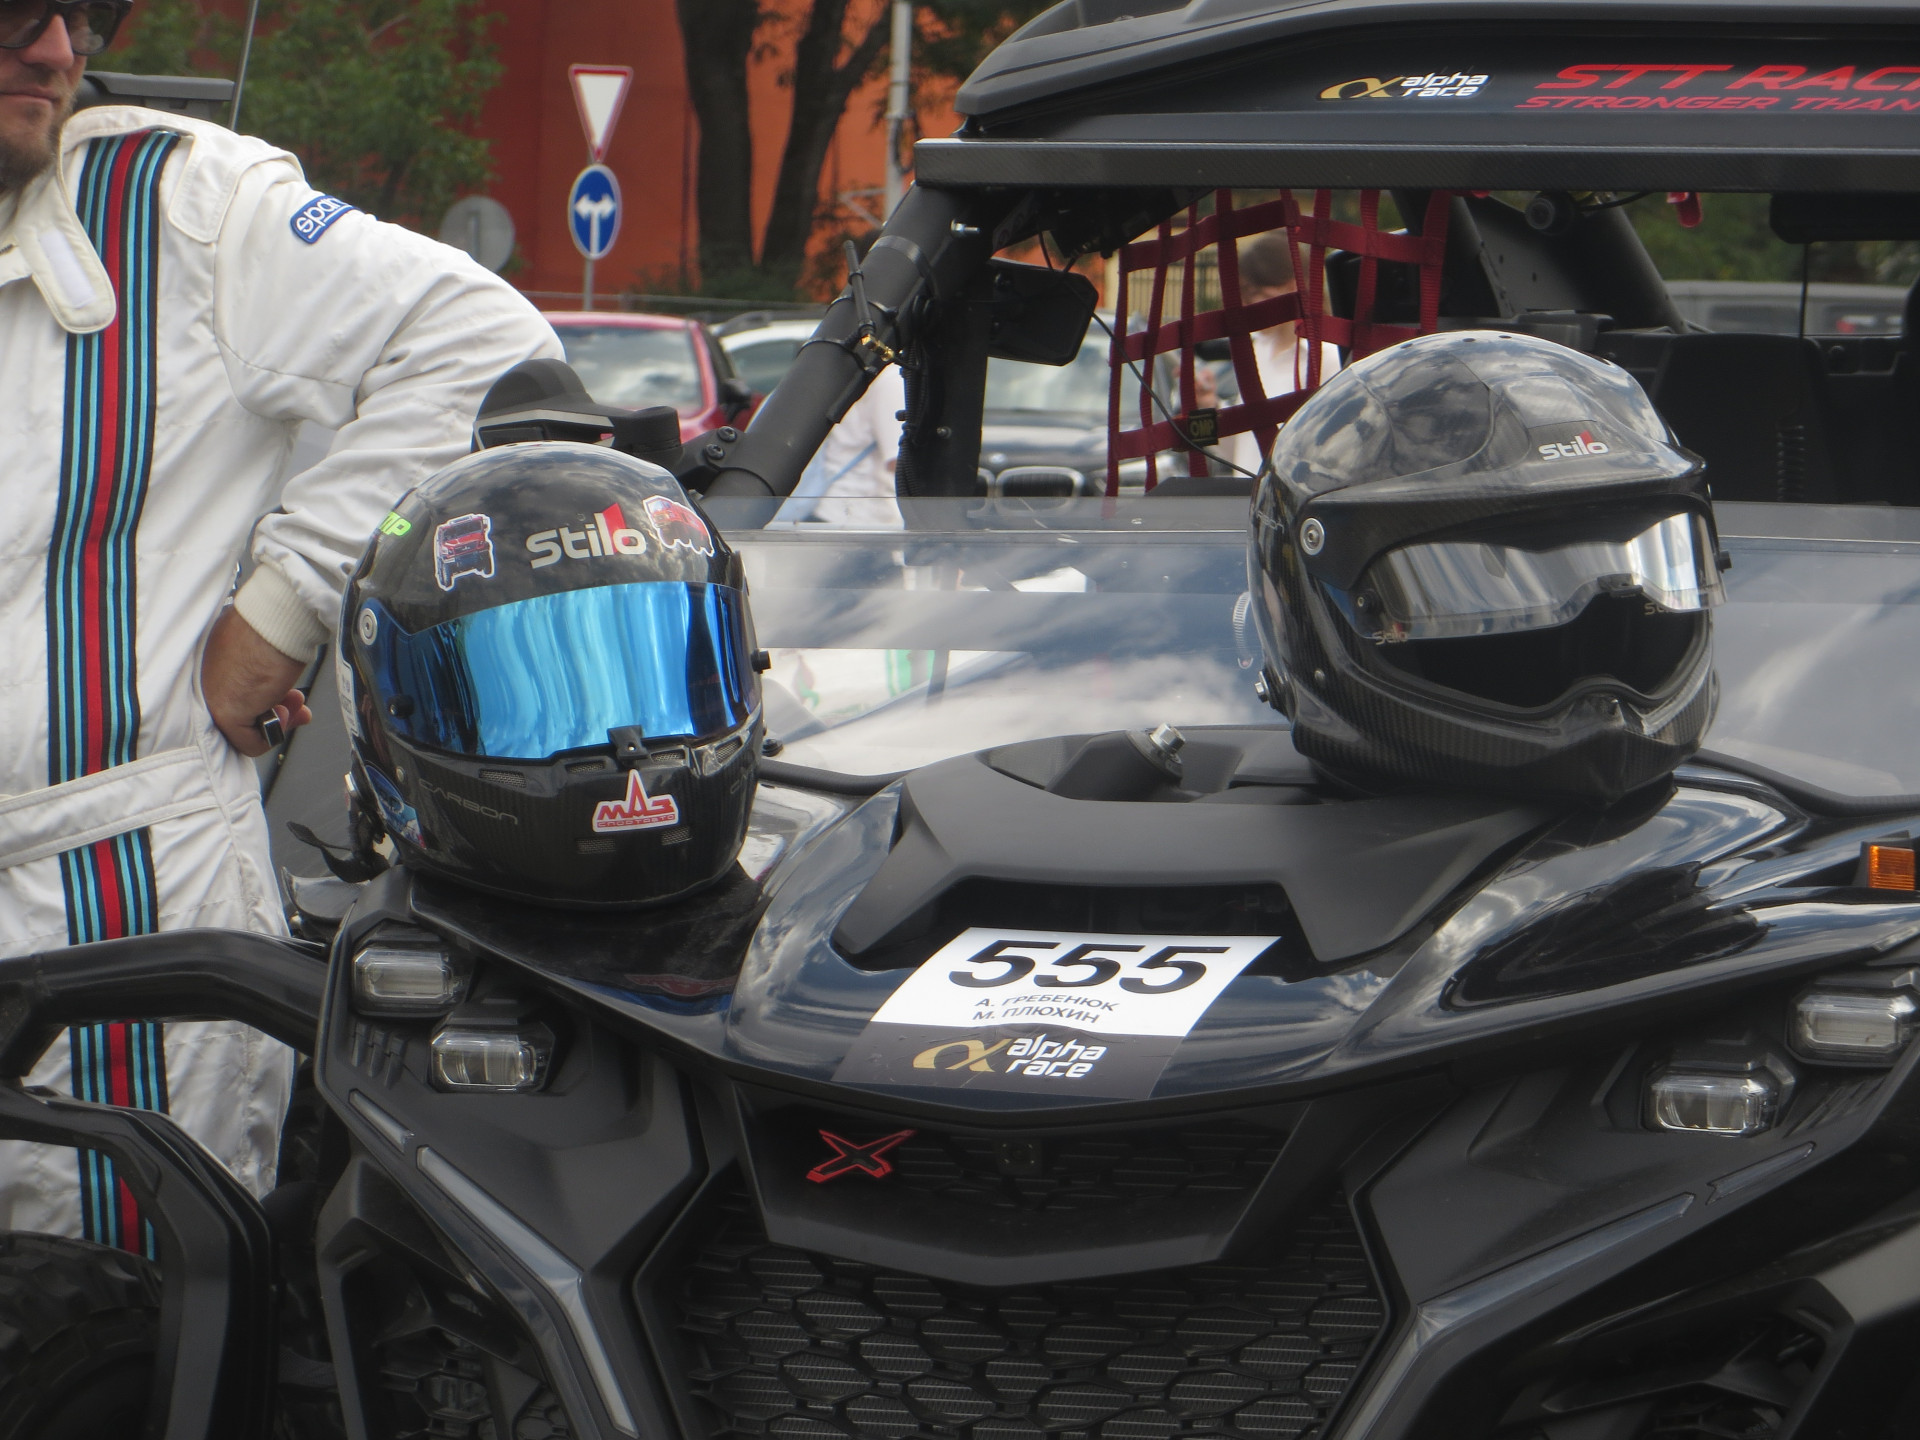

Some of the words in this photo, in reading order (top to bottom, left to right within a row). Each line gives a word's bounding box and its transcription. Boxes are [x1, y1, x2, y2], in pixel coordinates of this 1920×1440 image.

[1401, 72, 1489, 90] alpha
[1535, 64, 1734, 89] STT
[1402, 86, 1478, 97] race
[1514, 96, 1780, 110] STRONGER
[948, 940, 1231, 994] 555
[974, 998, 995, 1008] А.
[1001, 994, 1120, 1012] ГРЕБЕНЮК
[972, 1010, 995, 1021] М.
[1001, 1006, 1100, 1023] ПЛЮХИН
[1006, 1033, 1107, 1062] alpha
[1005, 1059, 1094, 1078] race
